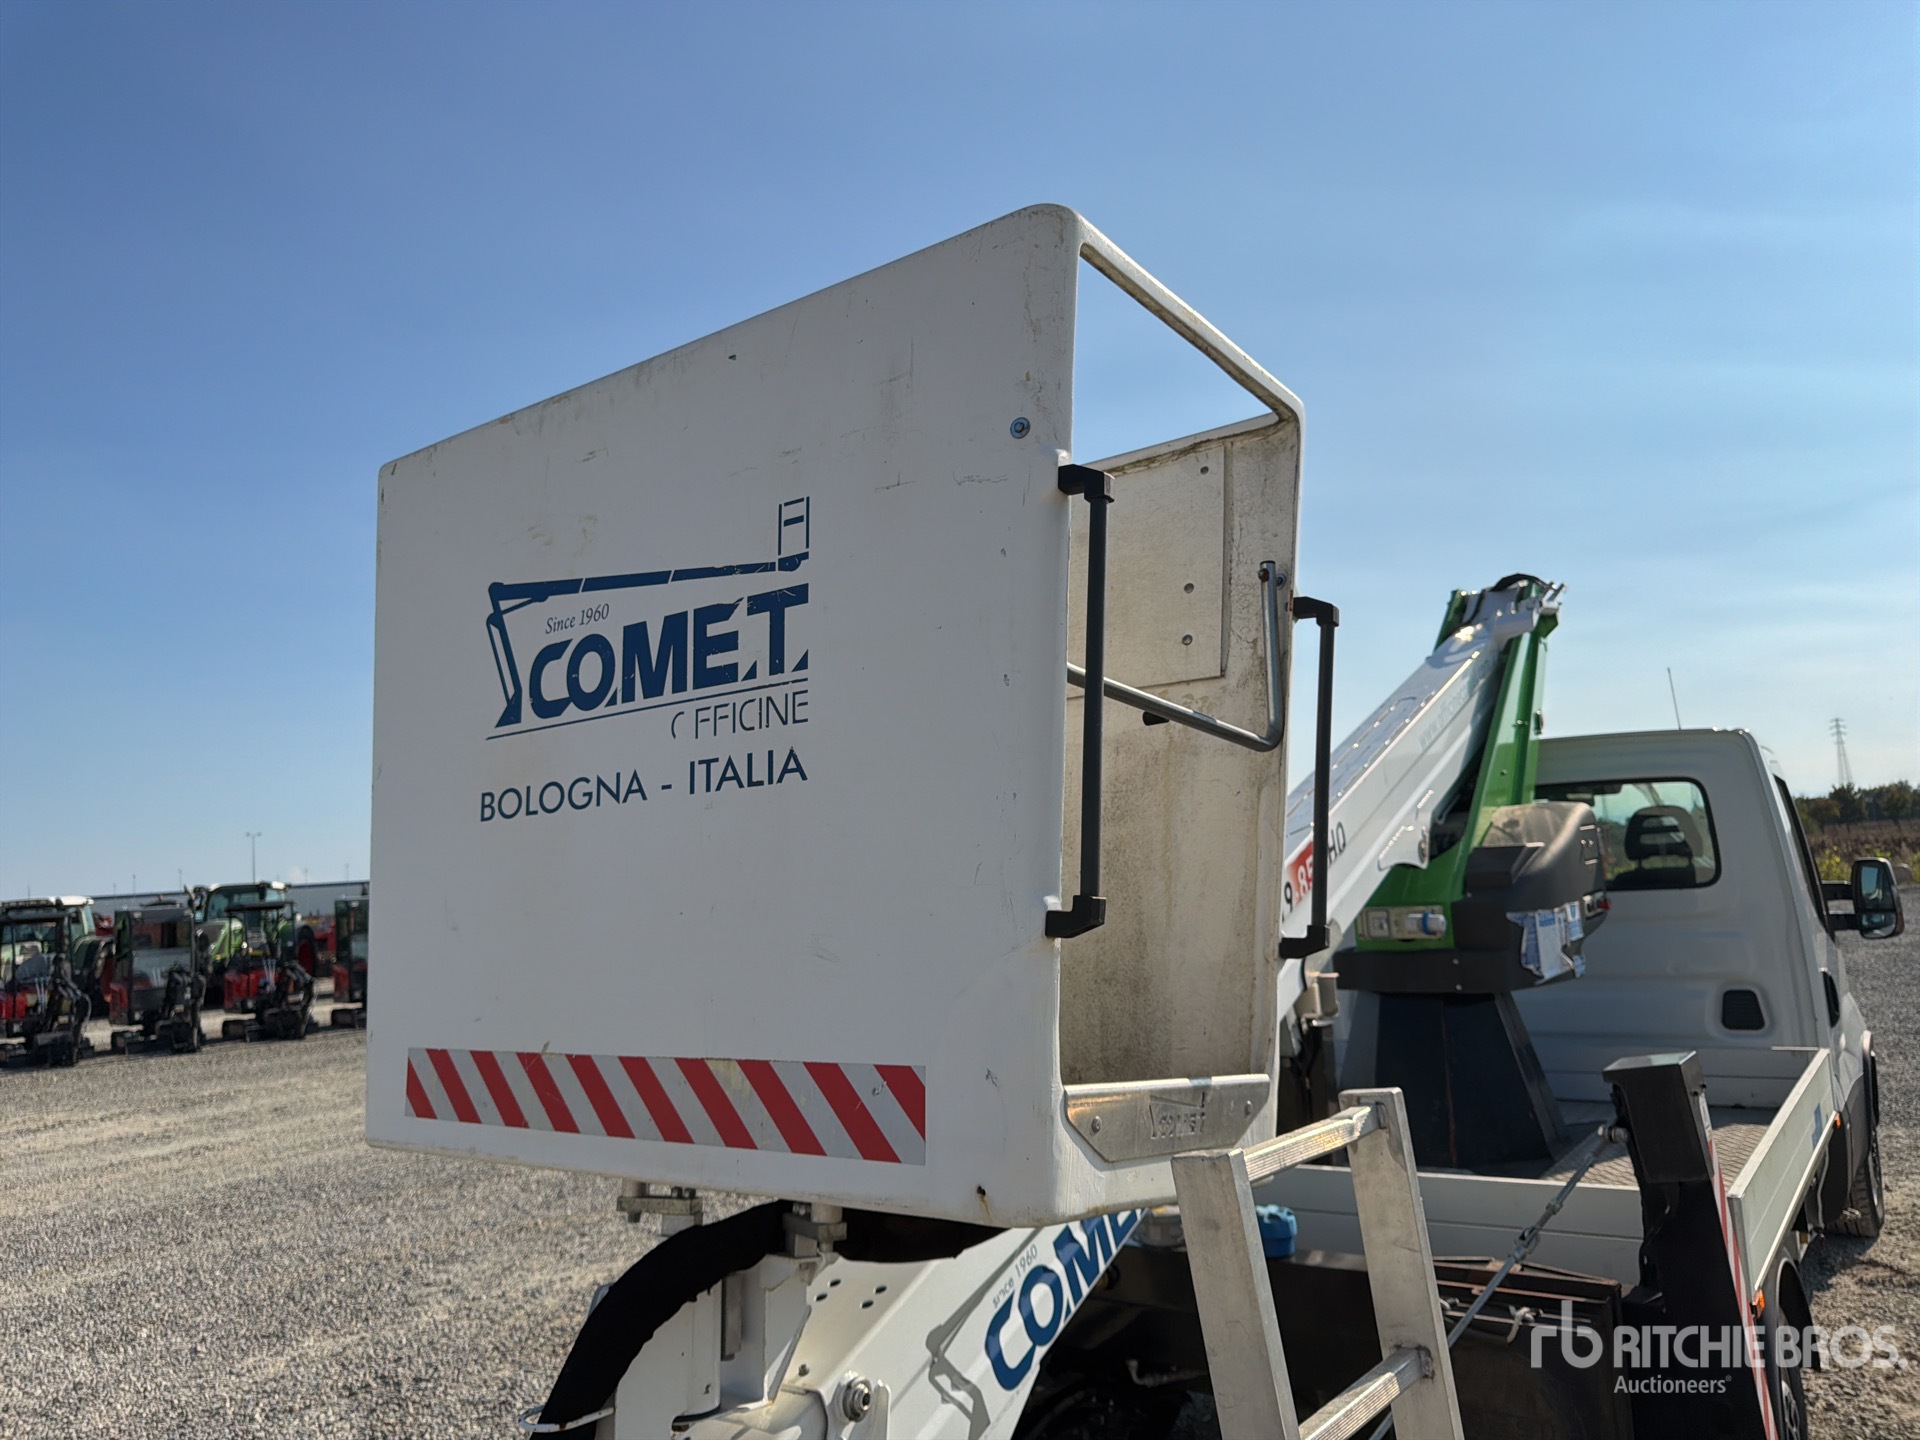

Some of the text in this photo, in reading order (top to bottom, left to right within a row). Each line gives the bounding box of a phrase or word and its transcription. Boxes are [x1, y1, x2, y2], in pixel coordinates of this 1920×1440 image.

[545, 603, 610, 635] Since 1960
[480, 769, 649, 822] BOLOGNA
[689, 746, 809, 795] ITALIA
[1015, 1243, 1038, 1278] 1960
